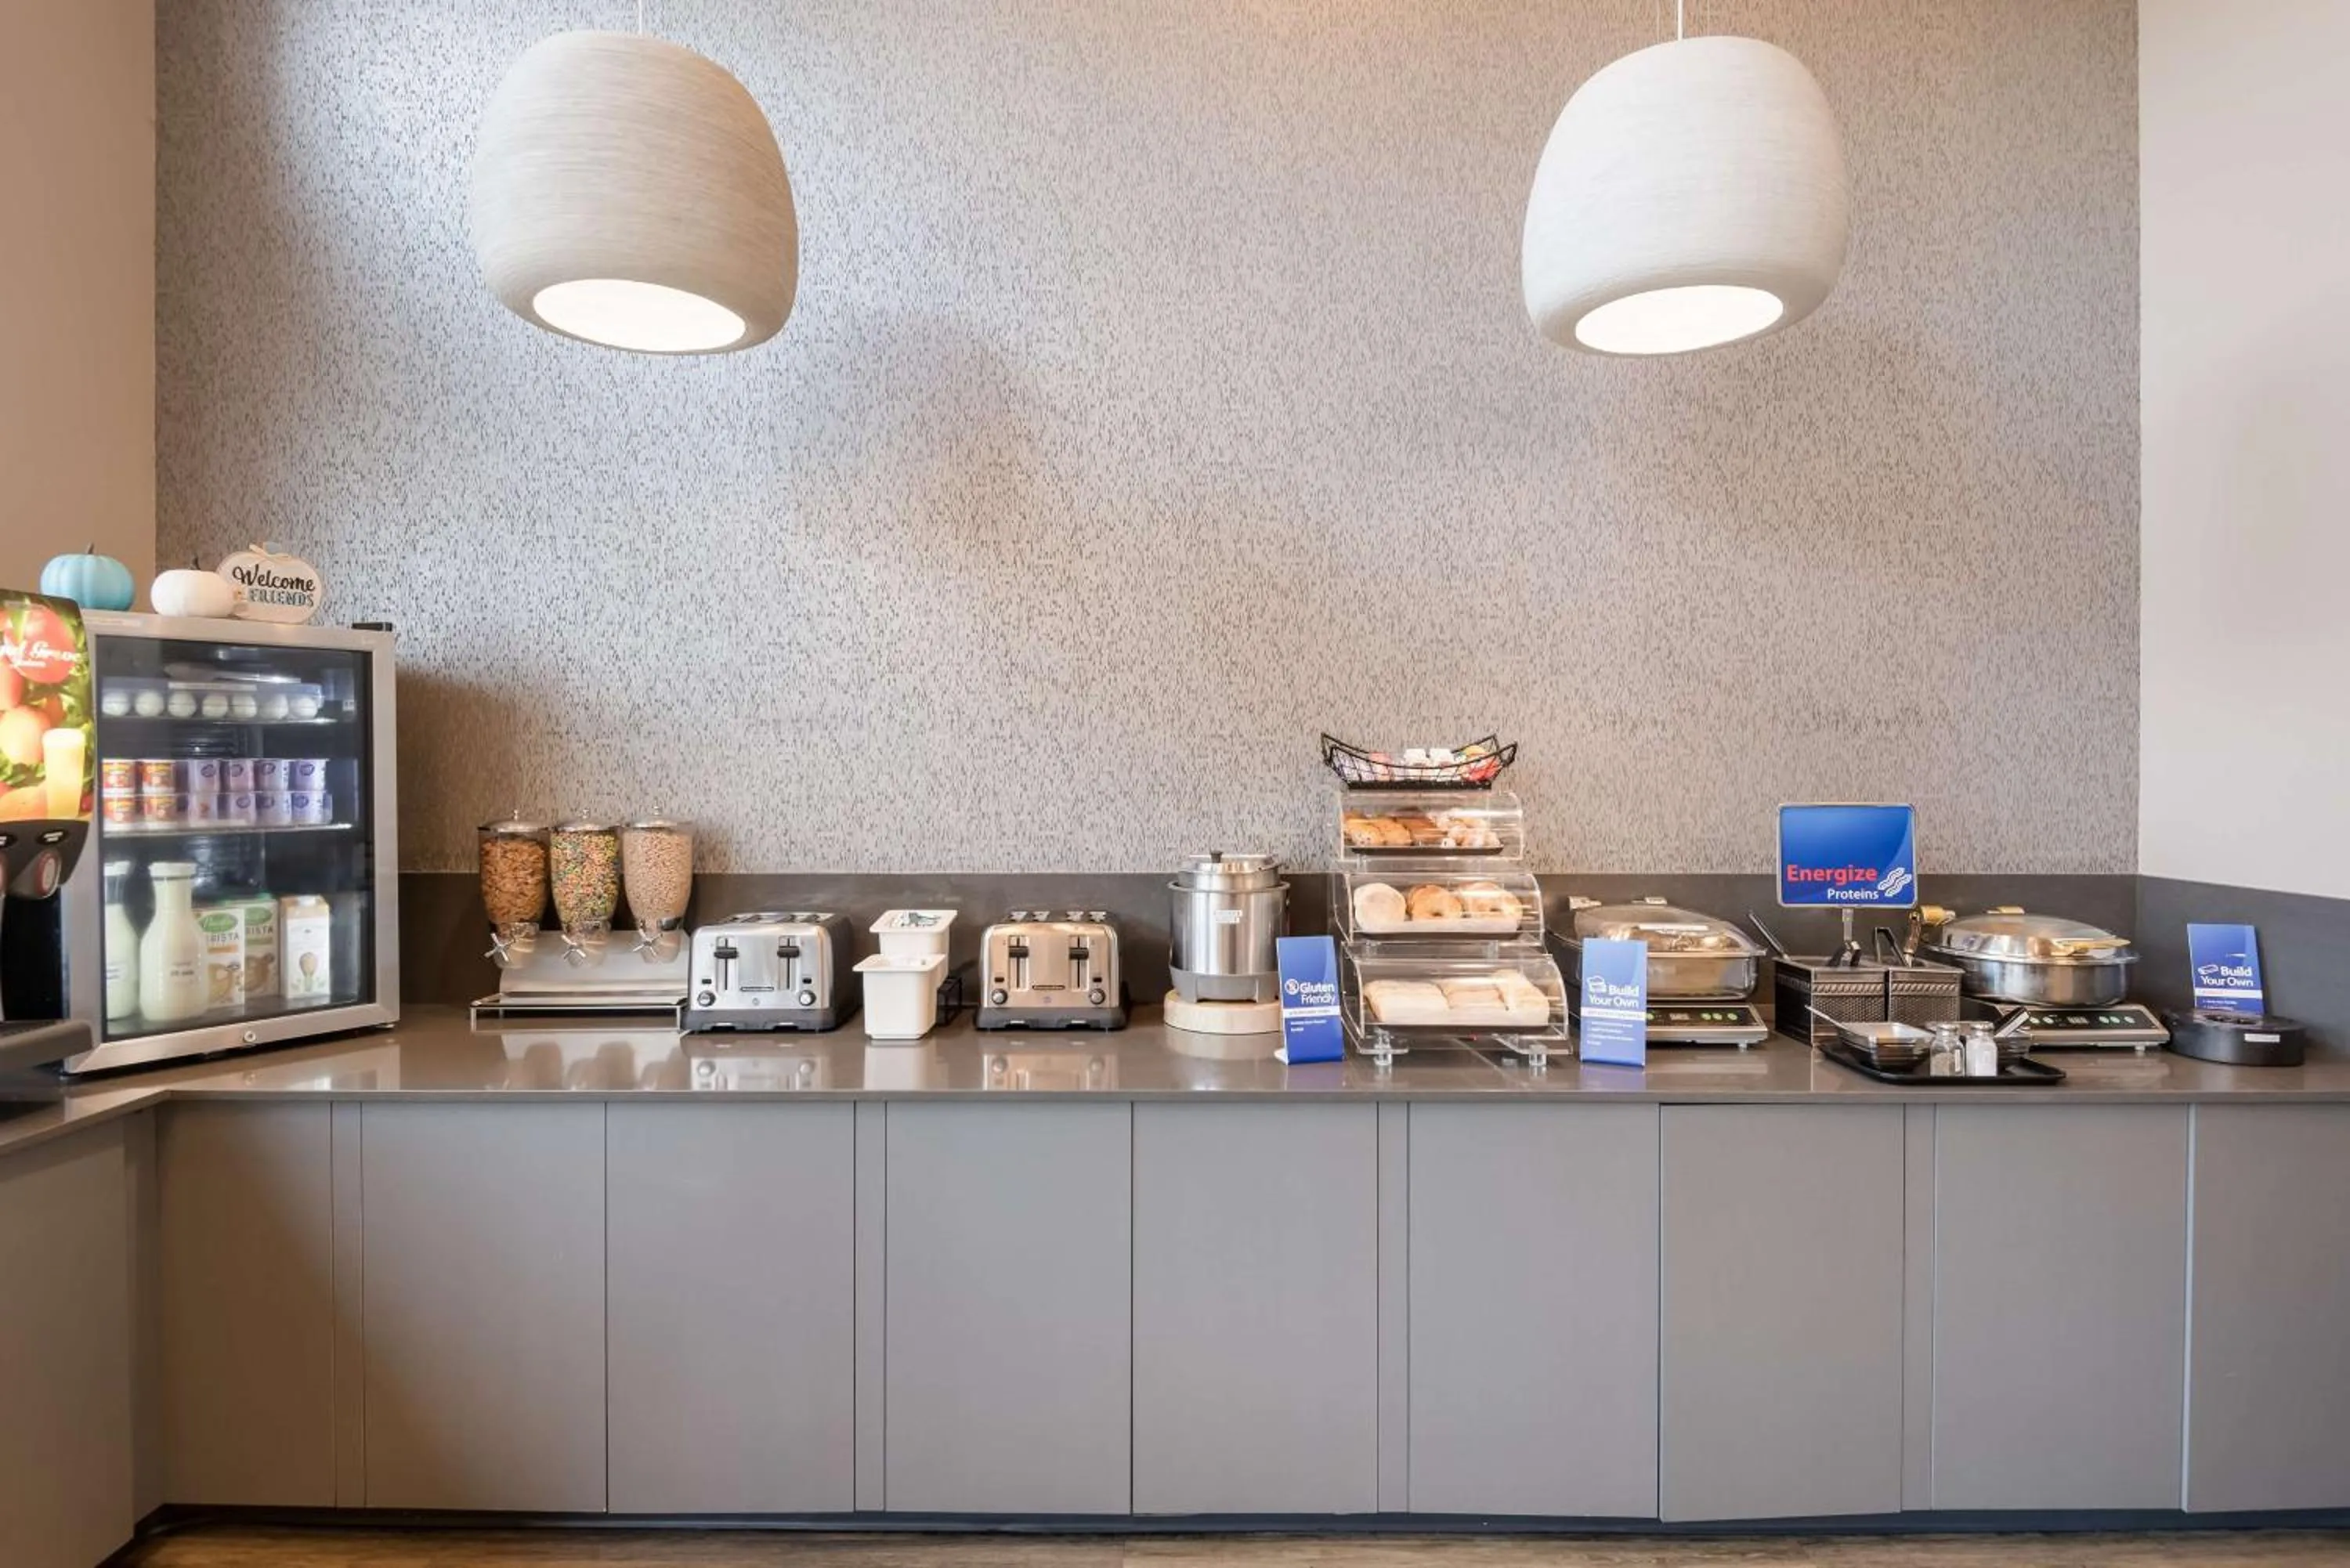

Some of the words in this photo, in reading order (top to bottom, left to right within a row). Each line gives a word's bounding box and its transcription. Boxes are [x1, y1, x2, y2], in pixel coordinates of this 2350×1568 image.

[232, 564, 315, 591] Welcome
[248, 587, 313, 608] FRIENDS
[1786, 865, 1878, 886] Energize
[1827, 888, 1879, 900] Proteins
[2220, 966, 2253, 977] Build
[1300, 981, 1335, 993] Gluten
[2200, 975, 2225, 986] Your
[2227, 977, 2254, 987] Own
[1608, 985, 1640, 996] Build
[1301, 992, 1336, 1006] Friendly
[1589, 994, 1612, 1006] Your
[1614, 995, 1639, 1009] Own
